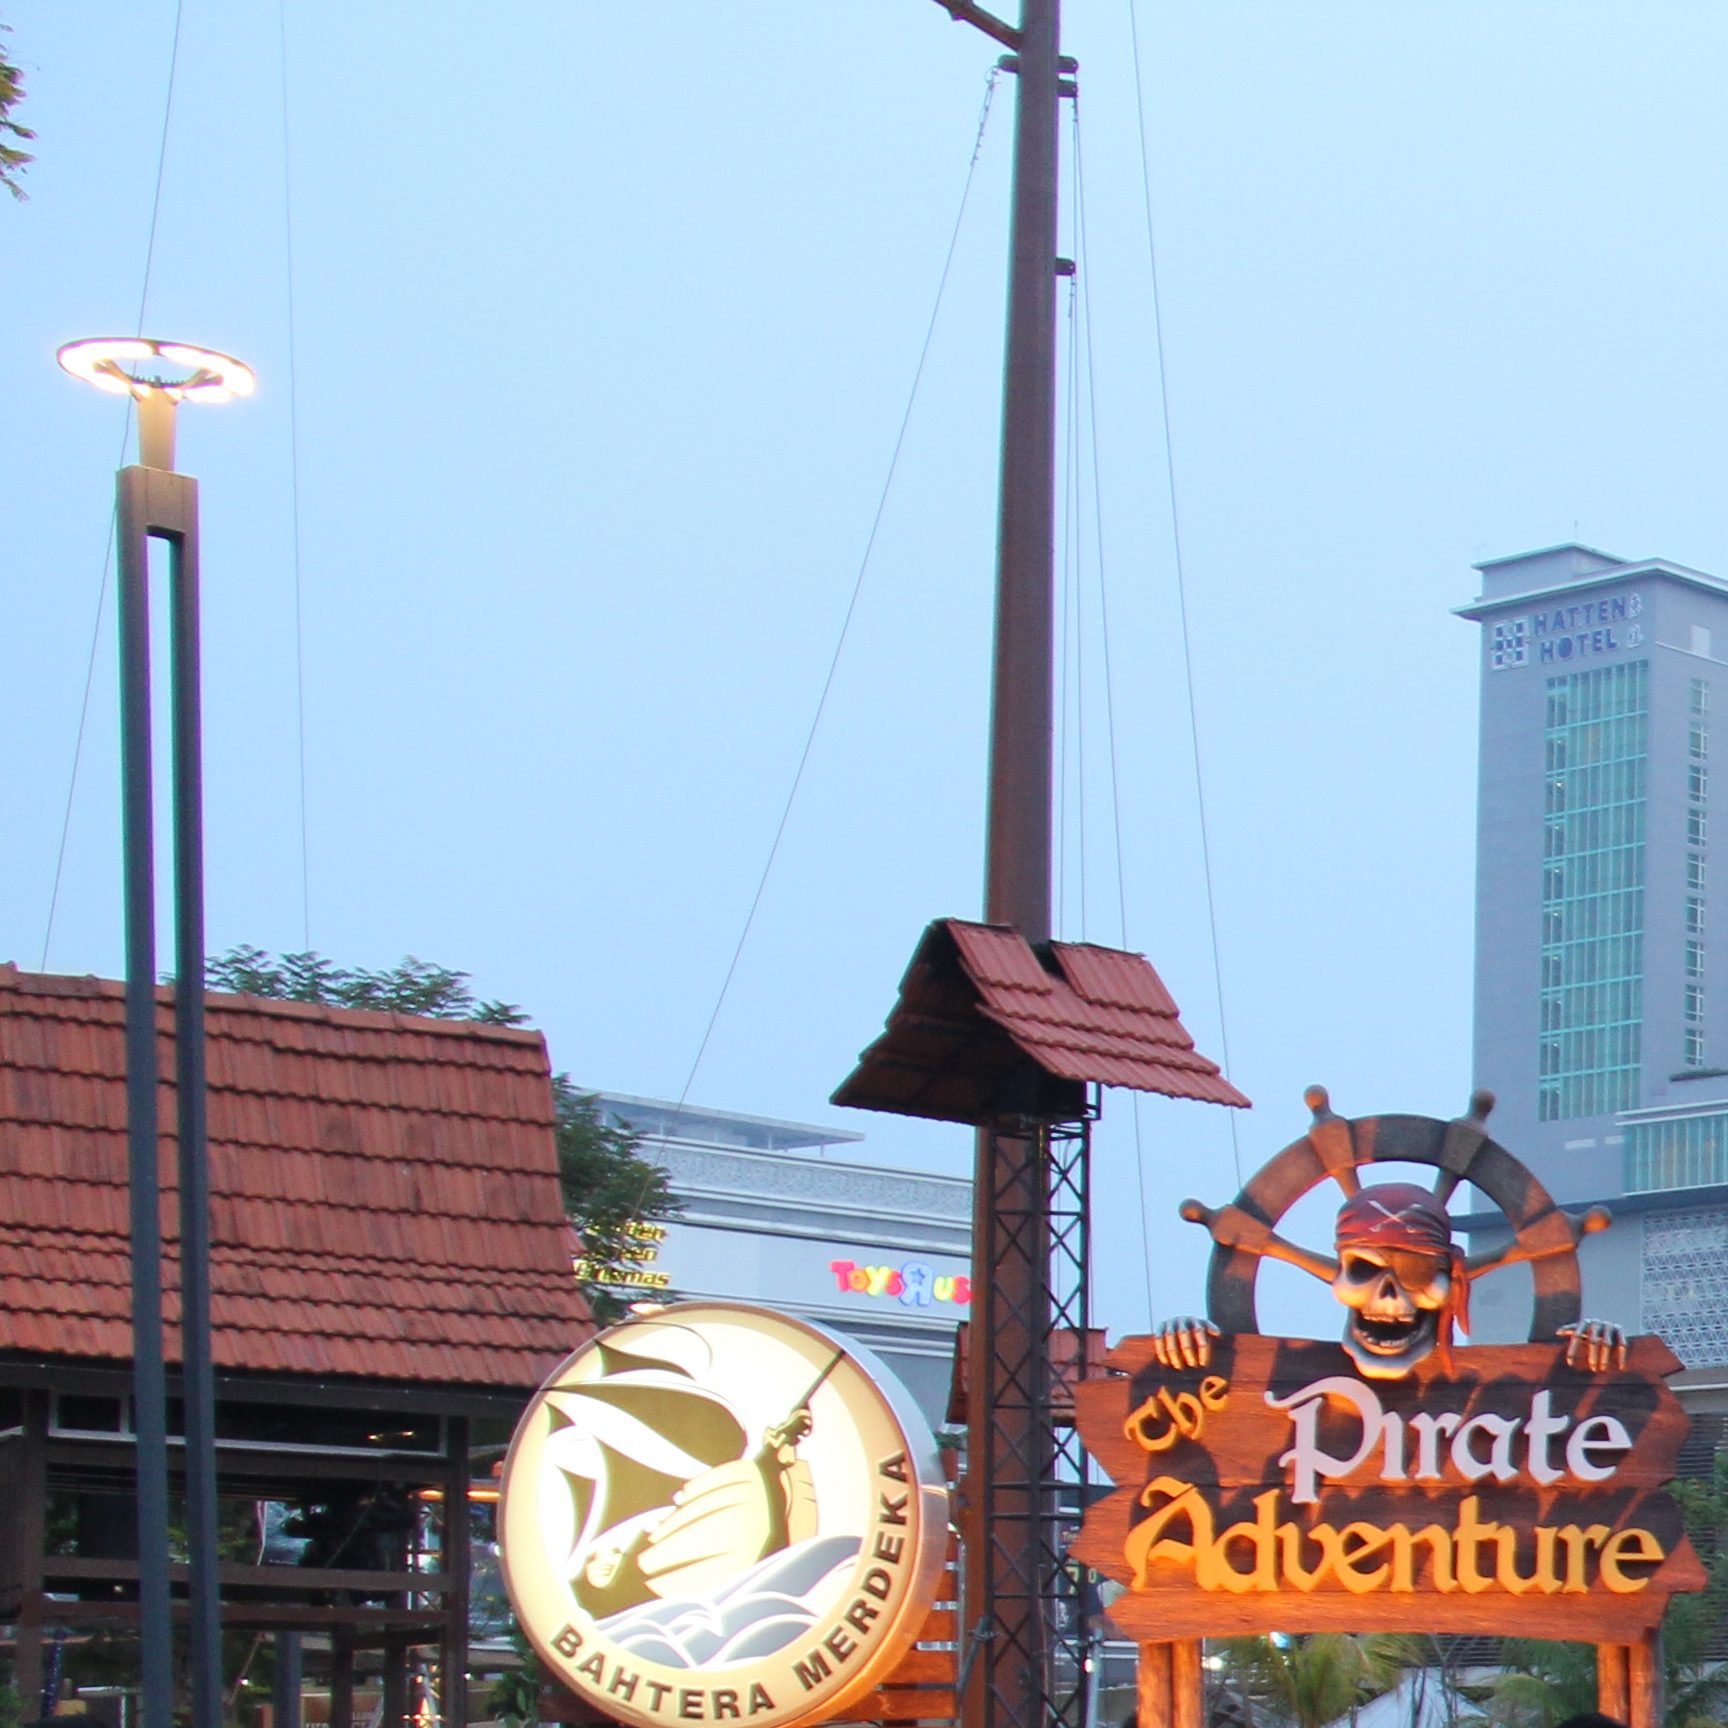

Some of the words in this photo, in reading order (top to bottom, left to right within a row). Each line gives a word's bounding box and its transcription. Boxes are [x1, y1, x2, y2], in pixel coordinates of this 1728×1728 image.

[1534, 597, 1625, 636] HATTEN
[1540, 628, 1617, 662] HOTEL
[1124, 1375, 1229, 1453] The
[1265, 1376, 1633, 1504] Pirate
[1123, 1476, 1665, 1594] Adventure
[549, 1621, 777, 1720] BAHTERA
[790, 1450, 909, 1692] MERDEKA
